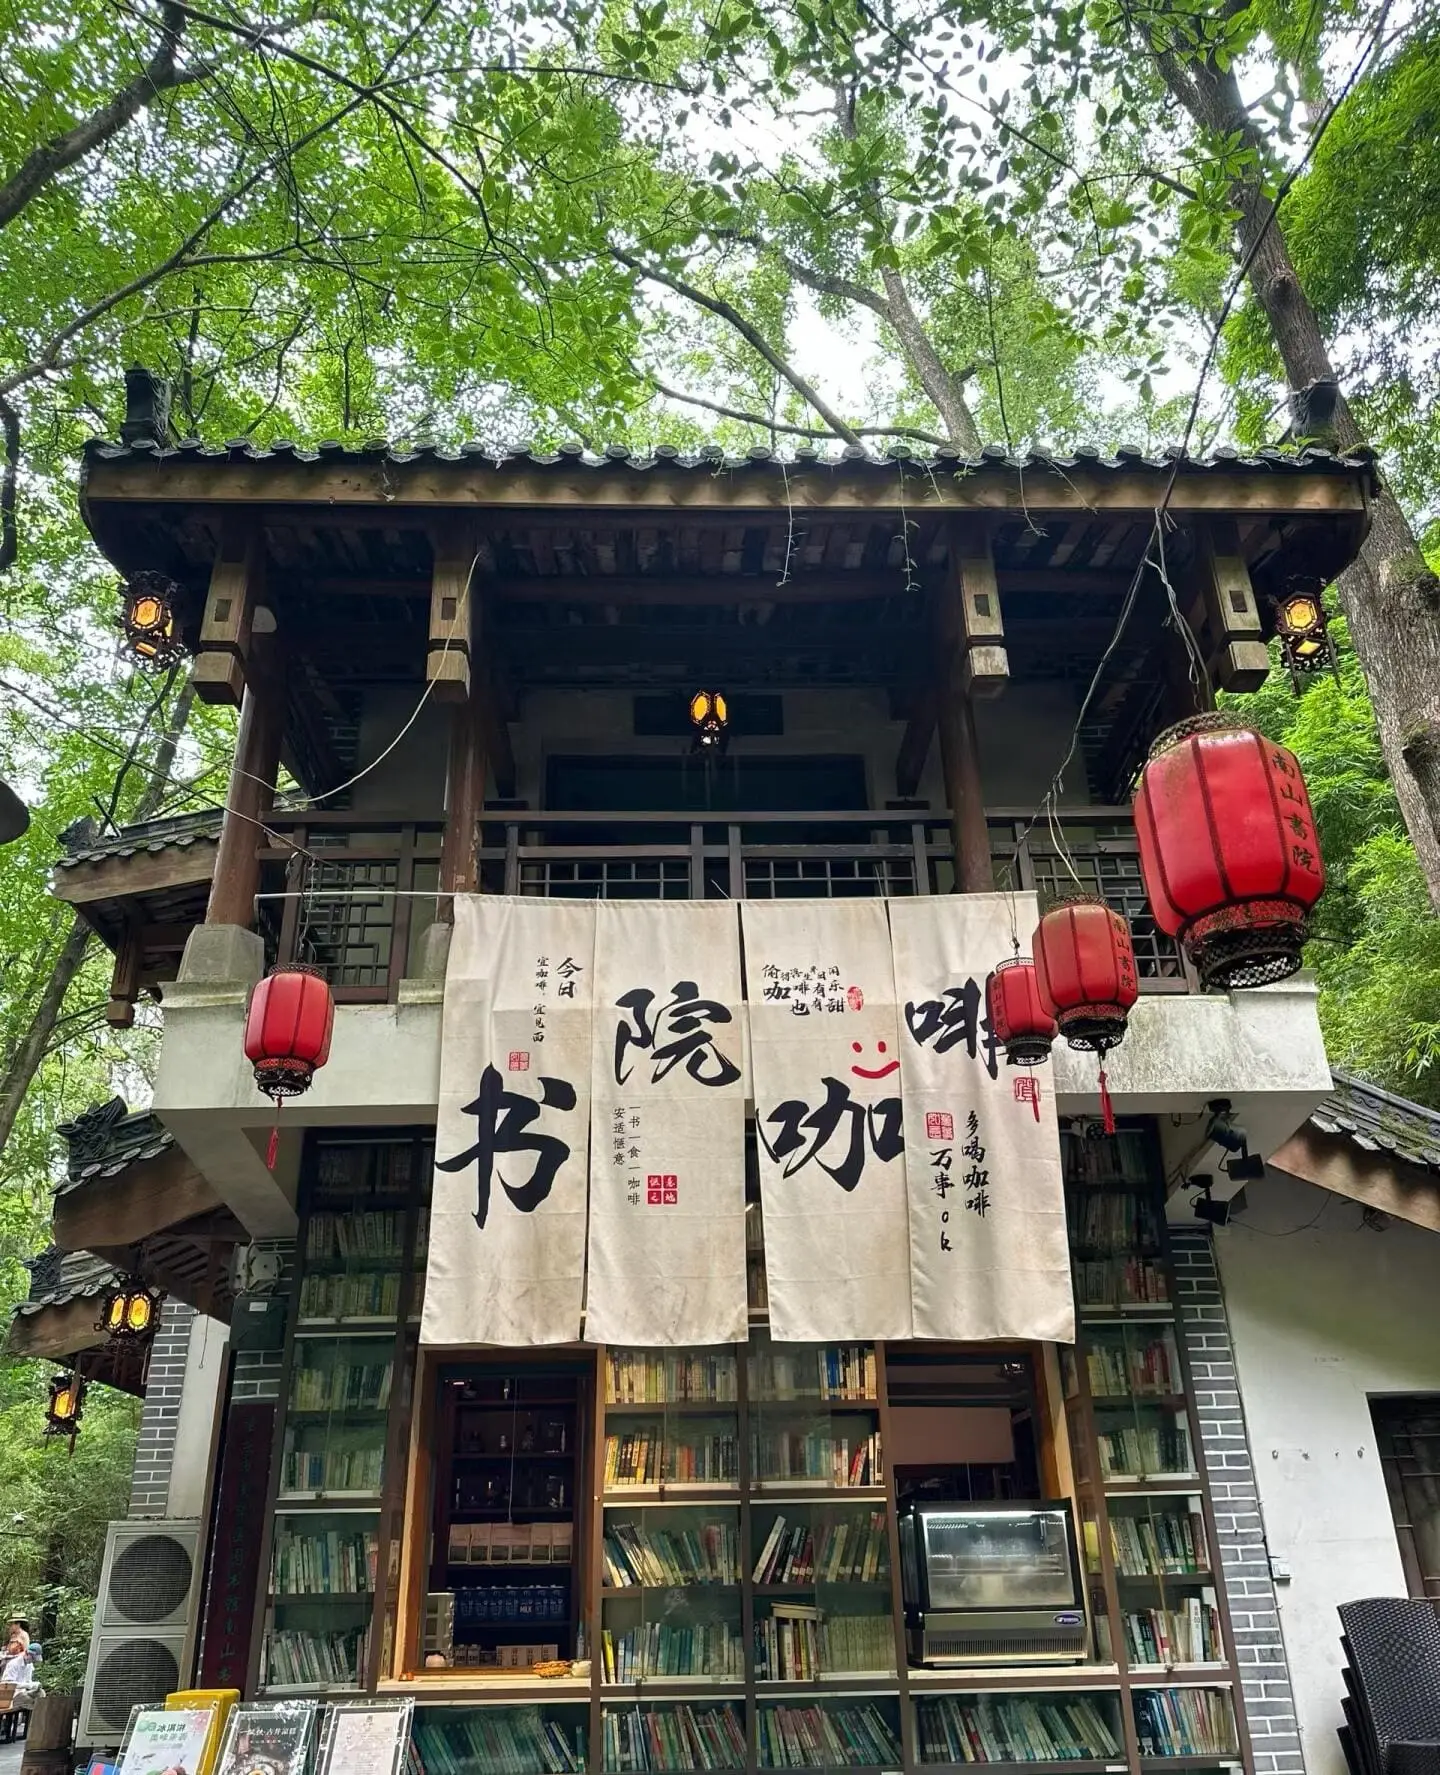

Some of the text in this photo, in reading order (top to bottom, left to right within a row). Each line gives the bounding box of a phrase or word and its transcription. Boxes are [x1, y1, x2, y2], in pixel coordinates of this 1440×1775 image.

[557, 957, 583, 999] 今日
[627, 1106, 641, 1206] 一书一食一咖啡
[961, 1110, 992, 1219] 多喝咖啡
